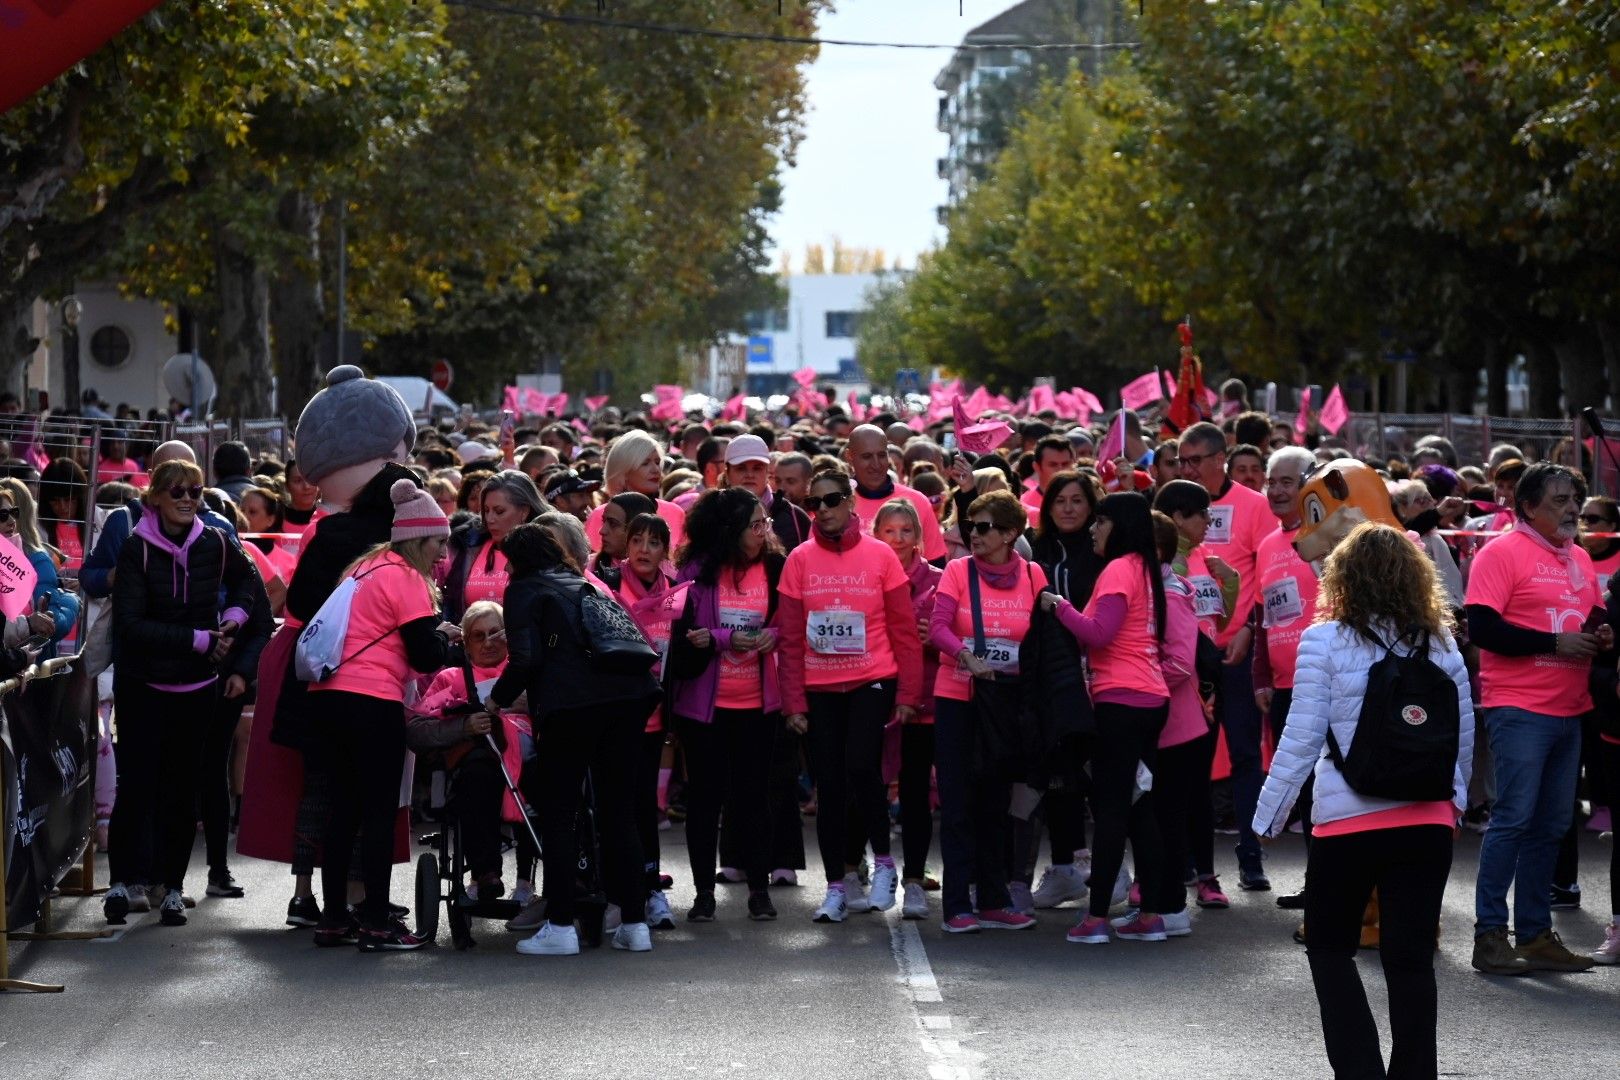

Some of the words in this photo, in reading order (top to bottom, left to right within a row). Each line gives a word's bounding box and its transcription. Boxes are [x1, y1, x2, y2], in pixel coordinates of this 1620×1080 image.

[0, 552, 26, 580] dent
[809, 570, 867, 588] Drasanvi
[984, 596, 1023, 609] asanvi
[1267, 592, 1288, 610] 0481
[817, 624, 853, 637] 3131
[985, 649, 1010, 661] 728
